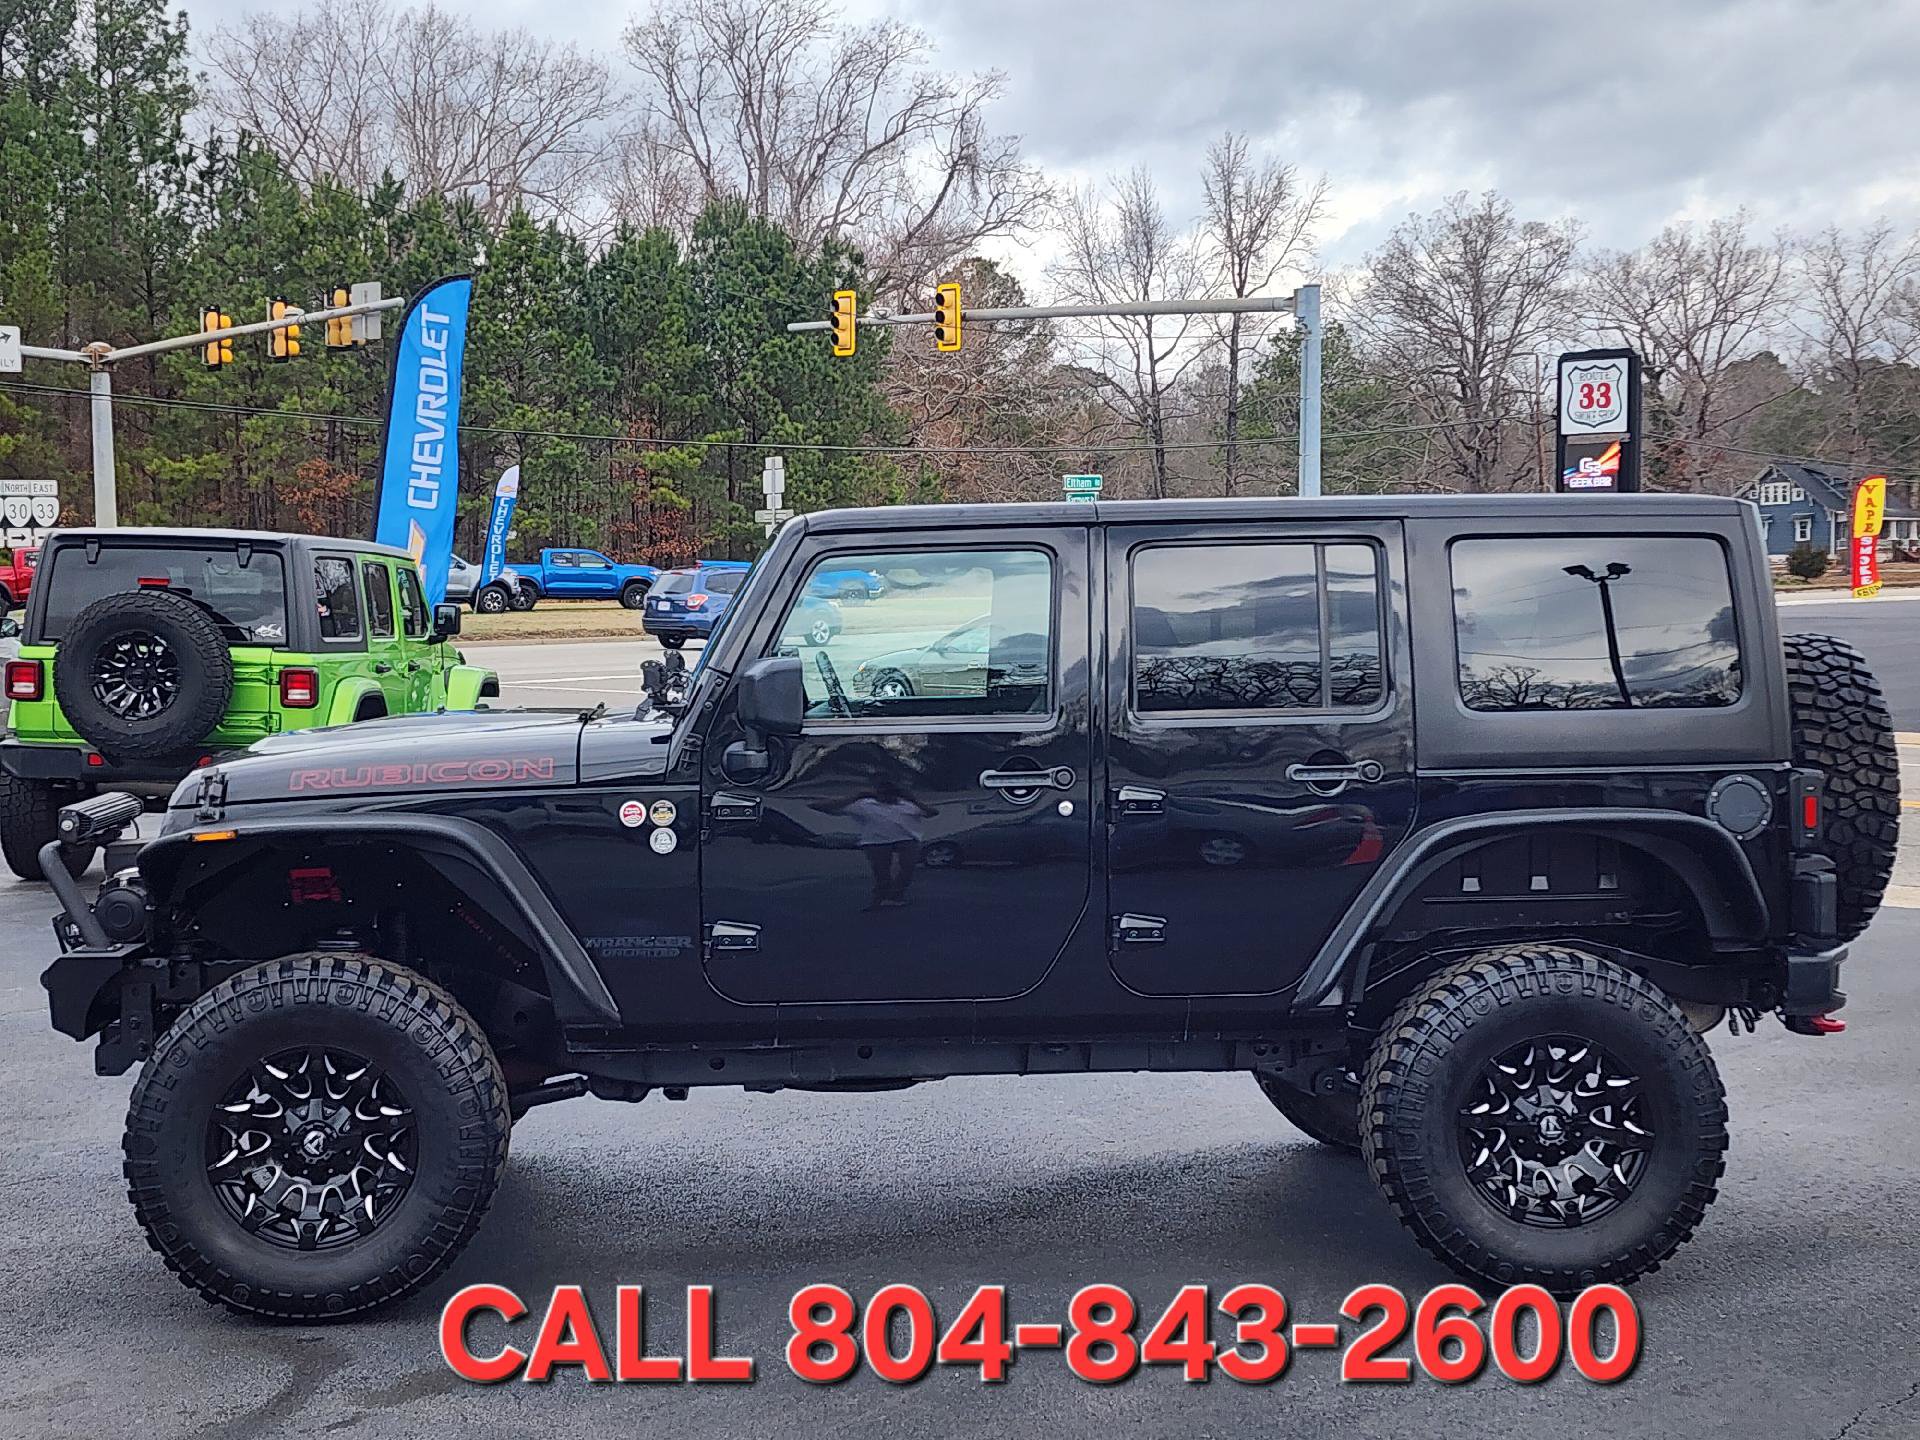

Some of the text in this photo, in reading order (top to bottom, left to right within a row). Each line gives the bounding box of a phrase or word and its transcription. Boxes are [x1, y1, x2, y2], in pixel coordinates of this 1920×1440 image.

[407, 303, 450, 510] CHEVROLET
[1579, 382, 1611, 409] 33
[4, 482, 54, 493] NORTH EAST
[9, 503, 55, 519] 30 33
[488, 496, 511, 581] CHEVROLET
[1859, 485, 1879, 586] VAPE SMOKE
[289, 757, 554, 791] RUBICON
